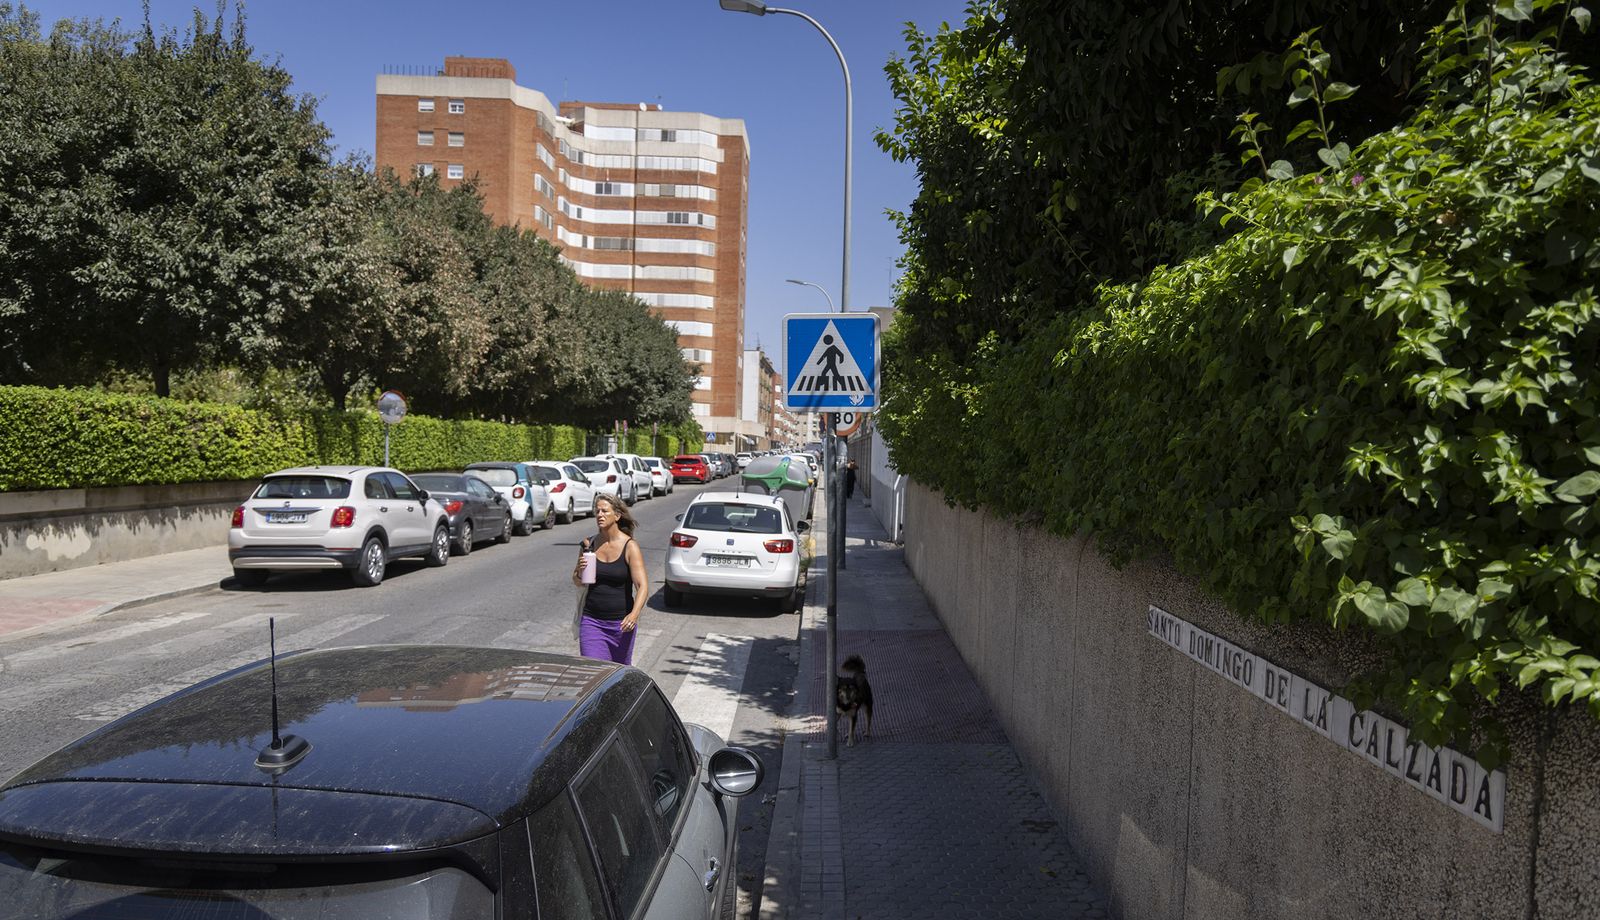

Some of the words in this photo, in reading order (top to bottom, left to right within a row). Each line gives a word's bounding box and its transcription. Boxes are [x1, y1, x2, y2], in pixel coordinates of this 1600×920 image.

[1148, 608, 1181, 647] SANTO
[1189, 630, 1253, 686] DOMINGO
[1265, 668, 1288, 708] DE
[1303, 687, 1328, 731] LA
[1350, 712, 1493, 822] CALZADA
